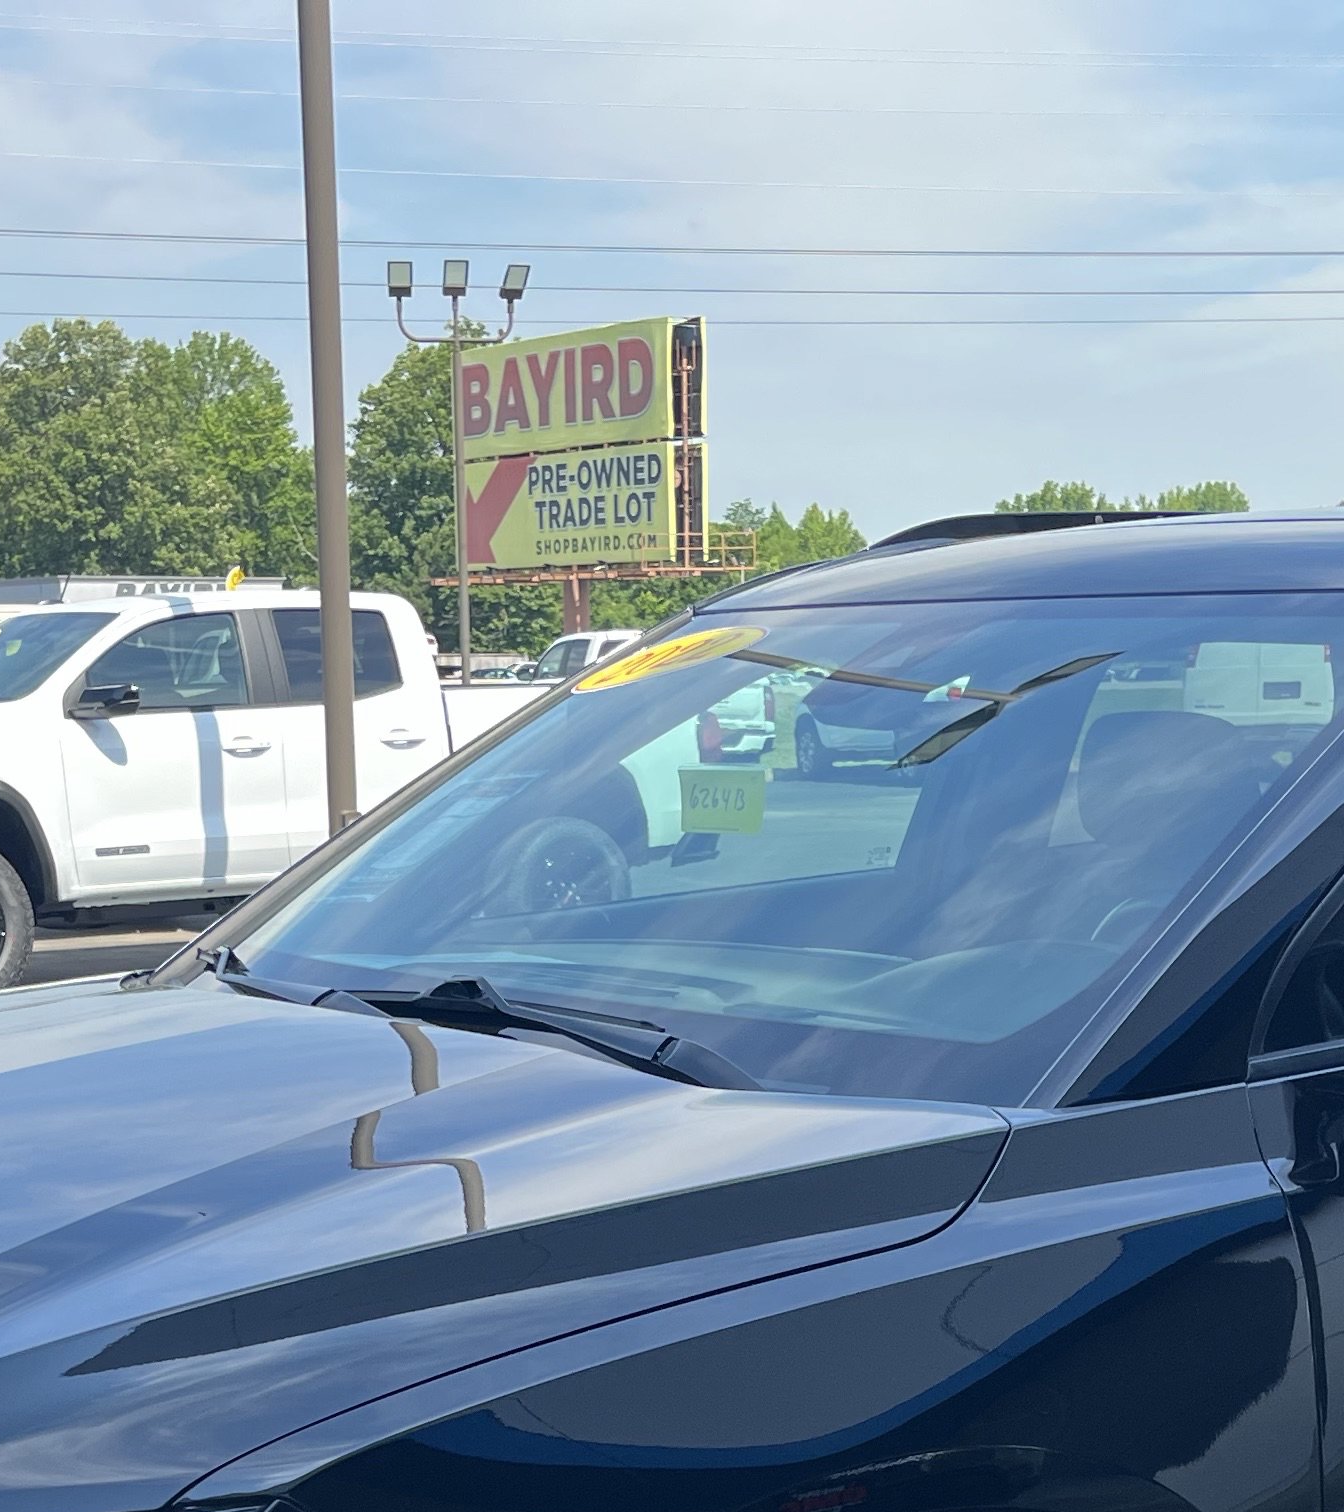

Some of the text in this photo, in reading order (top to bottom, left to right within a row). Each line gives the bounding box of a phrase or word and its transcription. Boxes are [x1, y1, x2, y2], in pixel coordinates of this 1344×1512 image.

[461, 336, 654, 438] BAYIRD
[528, 454, 661, 495] PRE-OWNED
[535, 491, 656, 529] TRADE LOT
[536, 533, 657, 555] SHOPBAYIRD.COM
